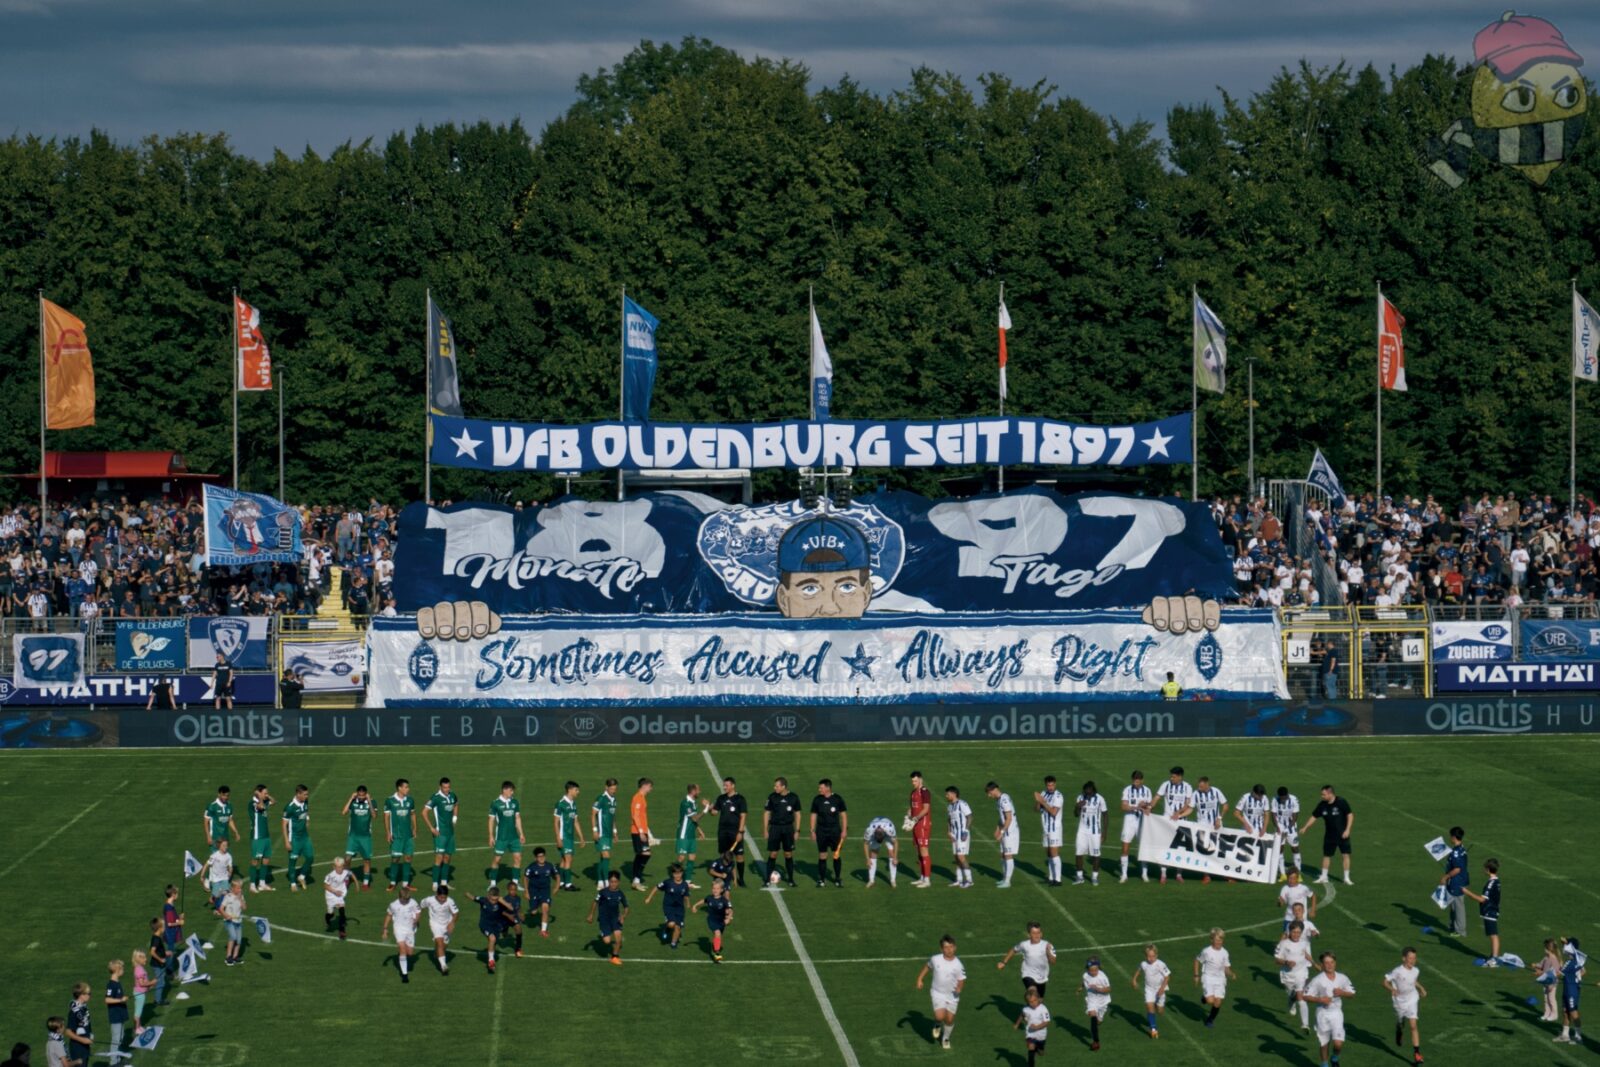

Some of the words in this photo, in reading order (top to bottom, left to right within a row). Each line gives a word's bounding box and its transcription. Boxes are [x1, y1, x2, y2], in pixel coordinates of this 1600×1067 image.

[592, 423, 891, 469] OLDENBURG
[905, 420, 1009, 466] SEIT
[1018, 421, 1135, 466] 1897
[137, 619, 186, 630] OLDENBURG
[475, 636, 664, 691] Sometimes
[683, 635, 832, 685] Accused
[895, 629, 1031, 688] Always
[1051, 634, 1160, 687] Right
[1292, 646, 1305, 658] J1
[1458, 664, 1594, 683] MATTHÄI
[619, 715, 752, 739] Oldenburg
[891, 706, 1175, 735] www.olantis.com
[1169, 826, 1274, 865] AUFST
[1223, 864, 1262, 877] oder
